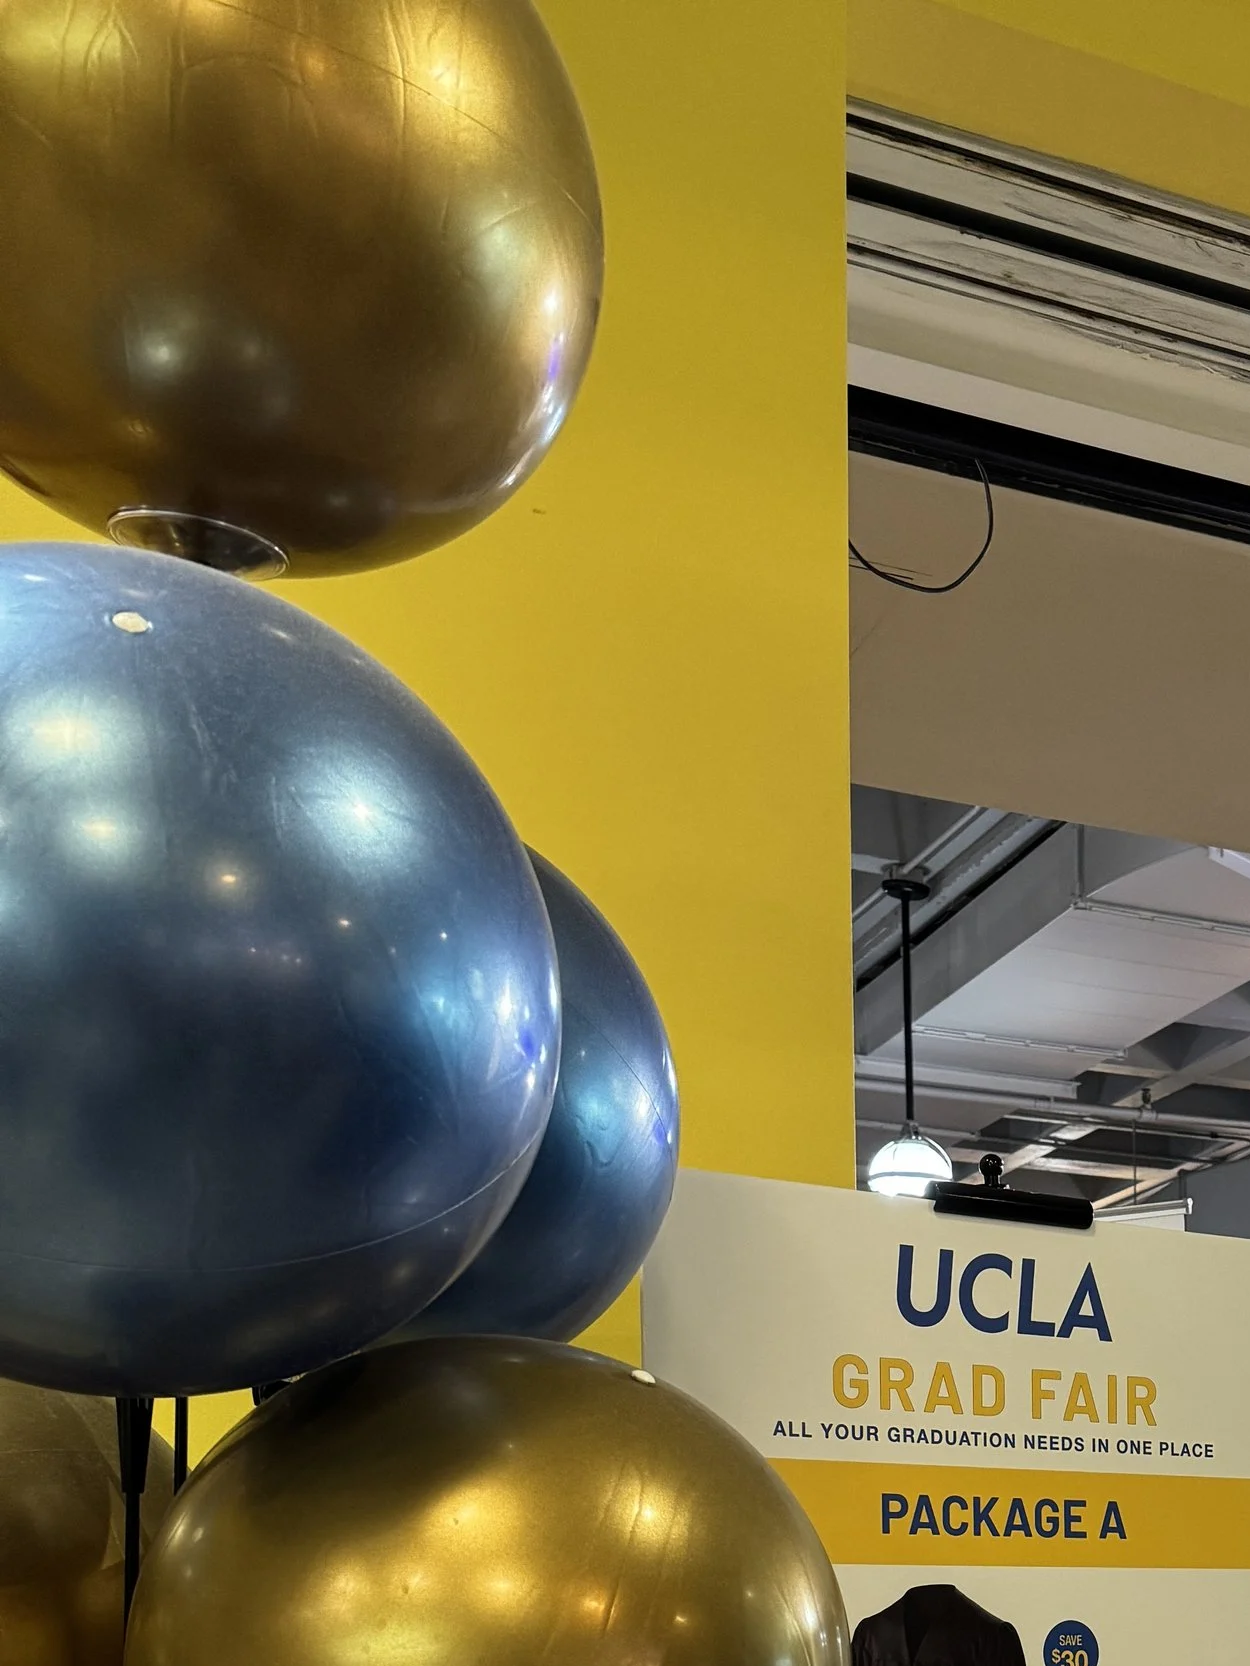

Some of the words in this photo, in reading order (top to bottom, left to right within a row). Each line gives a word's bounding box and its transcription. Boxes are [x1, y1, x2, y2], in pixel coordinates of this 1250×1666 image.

[897, 1244, 1113, 1342] UCLA
[832, 1354, 1005, 1417] GRAD
[1031, 1369, 1157, 1426] FAIR
[773, 1420, 812, 1438] ALL
[821, 1423, 879, 1441] YOUR
[888, 1427, 1015, 1448] GRADUATION
[1024, 1434, 1084, 1452] NEEDS
[1092, 1438, 1109, 1453] IN
[1116, 1439, 1152, 1455] ONE
[1160, 1442, 1214, 1458] PLACE
[882, 1493, 1087, 1539] PACKAGE
[1099, 1501, 1127, 1539] A
[1059, 1635, 1082, 1646] SAVE
